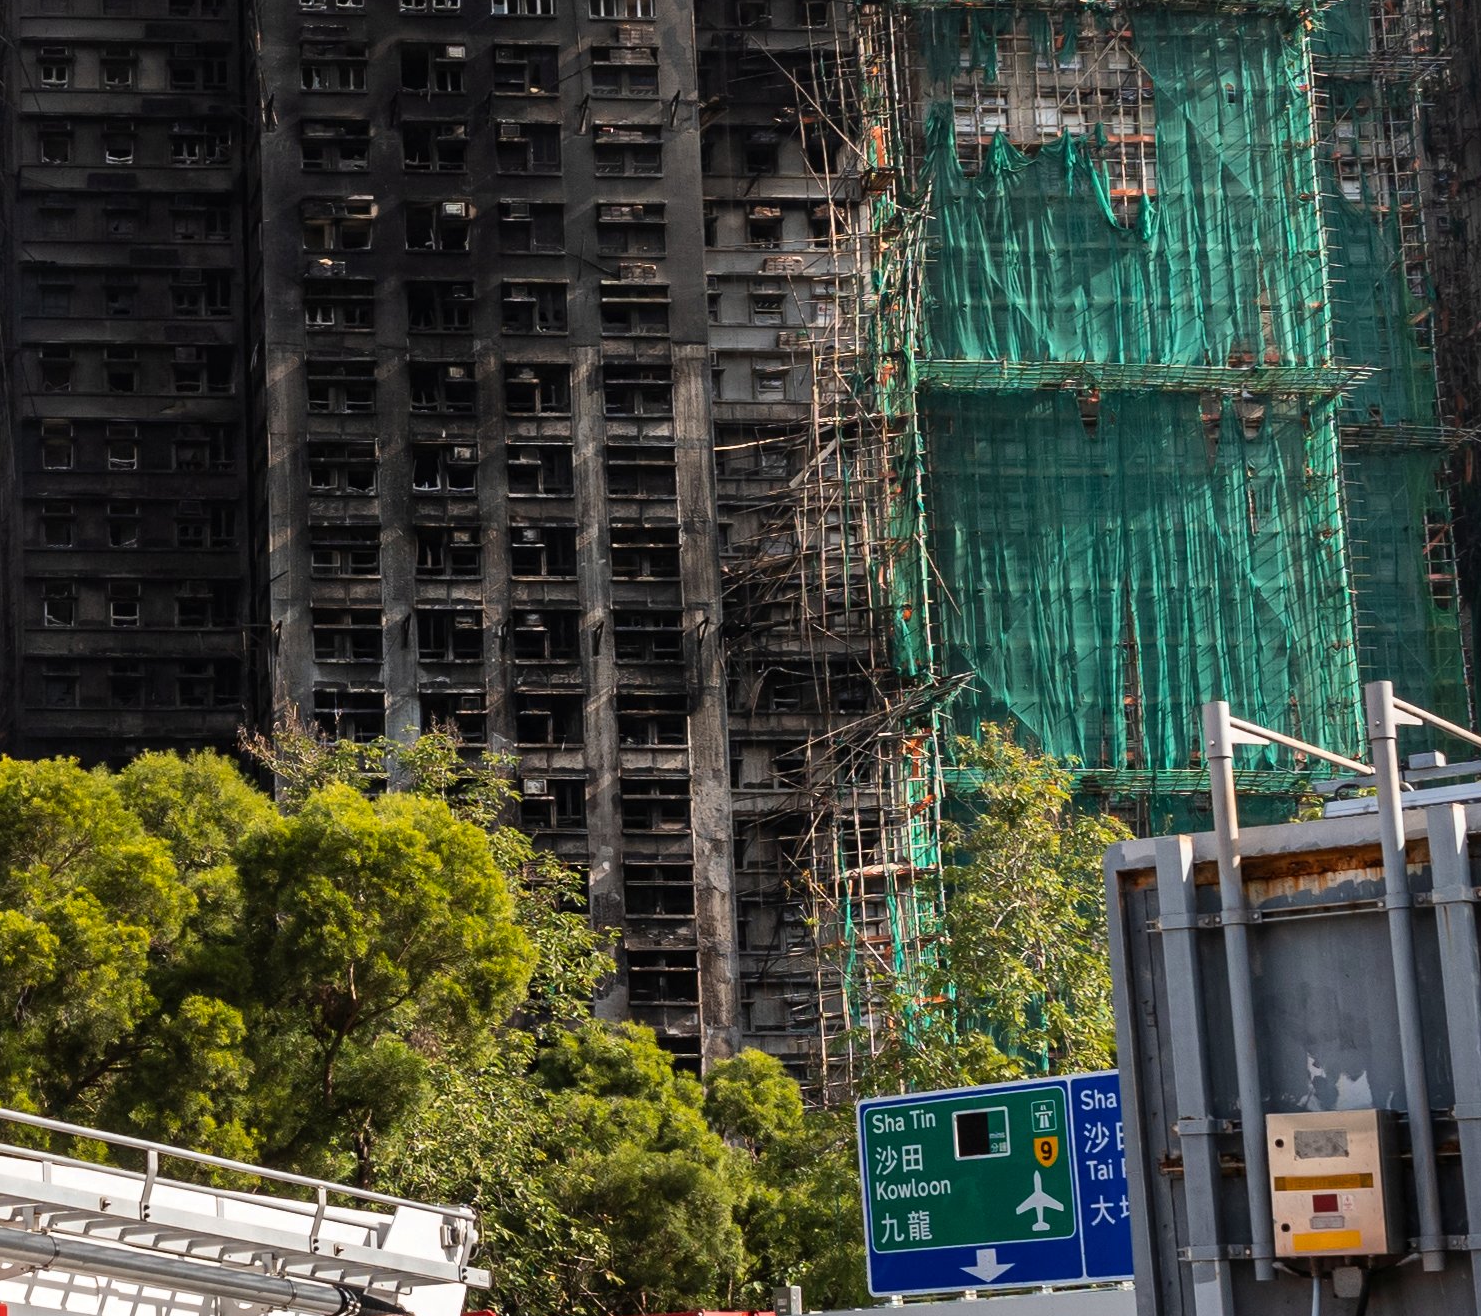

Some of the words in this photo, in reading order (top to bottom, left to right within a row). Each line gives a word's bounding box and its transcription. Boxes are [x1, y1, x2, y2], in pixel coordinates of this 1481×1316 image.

[1080, 1088, 1118, 1111] Sha
[872, 1114, 905, 1134] Sha
[909, 1109, 937, 1130] Tin
[875, 1144, 924, 1176] 沙田
[1040, 1140, 1052, 1161] 9
[1086, 1160, 1114, 1181] Tai
[876, 1179, 951, 1201] Kowloon
[881, 1210, 933, 1244] 九龍
